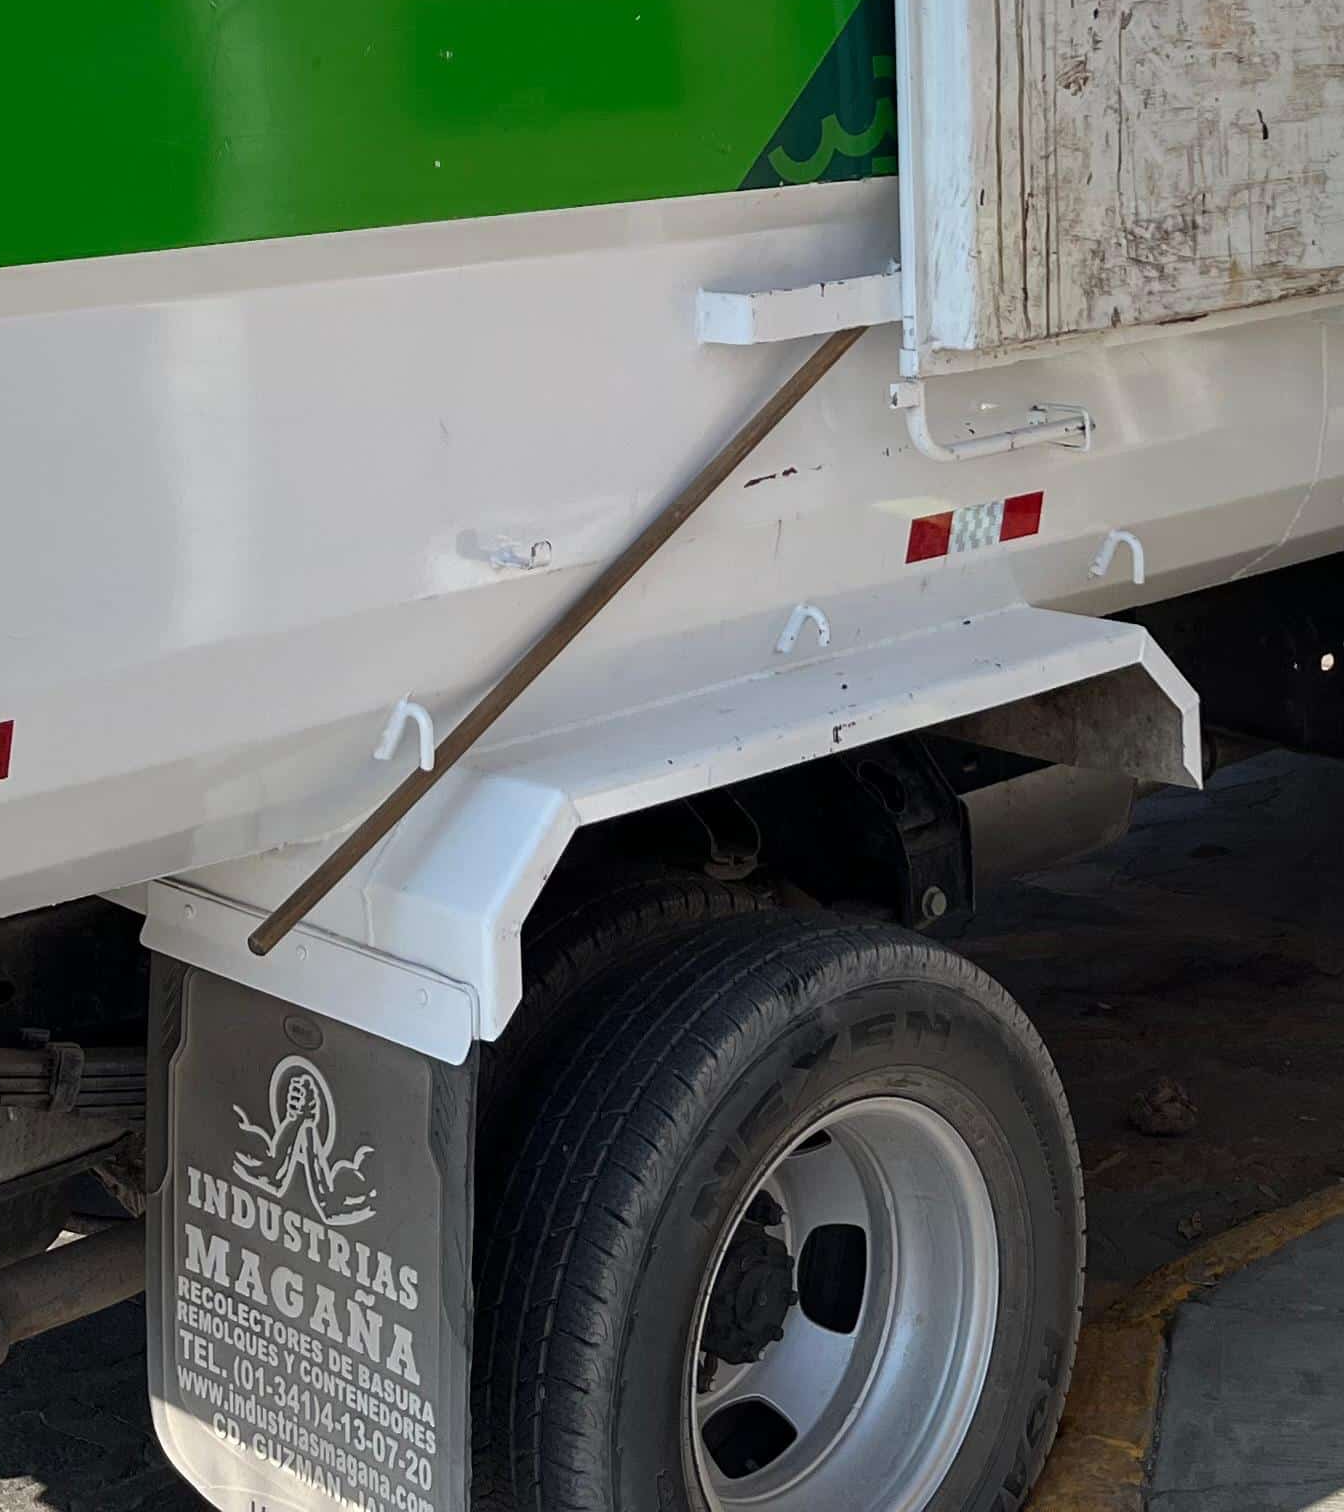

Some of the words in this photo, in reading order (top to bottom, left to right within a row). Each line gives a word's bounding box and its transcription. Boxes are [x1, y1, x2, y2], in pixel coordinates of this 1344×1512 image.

[184, 1223, 421, 1386] MAGAÑA
[187, 1167, 419, 1311] INDUSTRIAS
[177, 1299, 279, 1368] REMOLQUES
[284, 1350, 296, 1374] Y
[299, 1360, 437, 1455] CONTENEDORES
[178, 1275, 323, 1364] RECOLECTORES
[328, 1347, 353, 1381] DE
[358, 1363, 436, 1428] BASURA
[179, 1328, 228, 1378] TEL.
